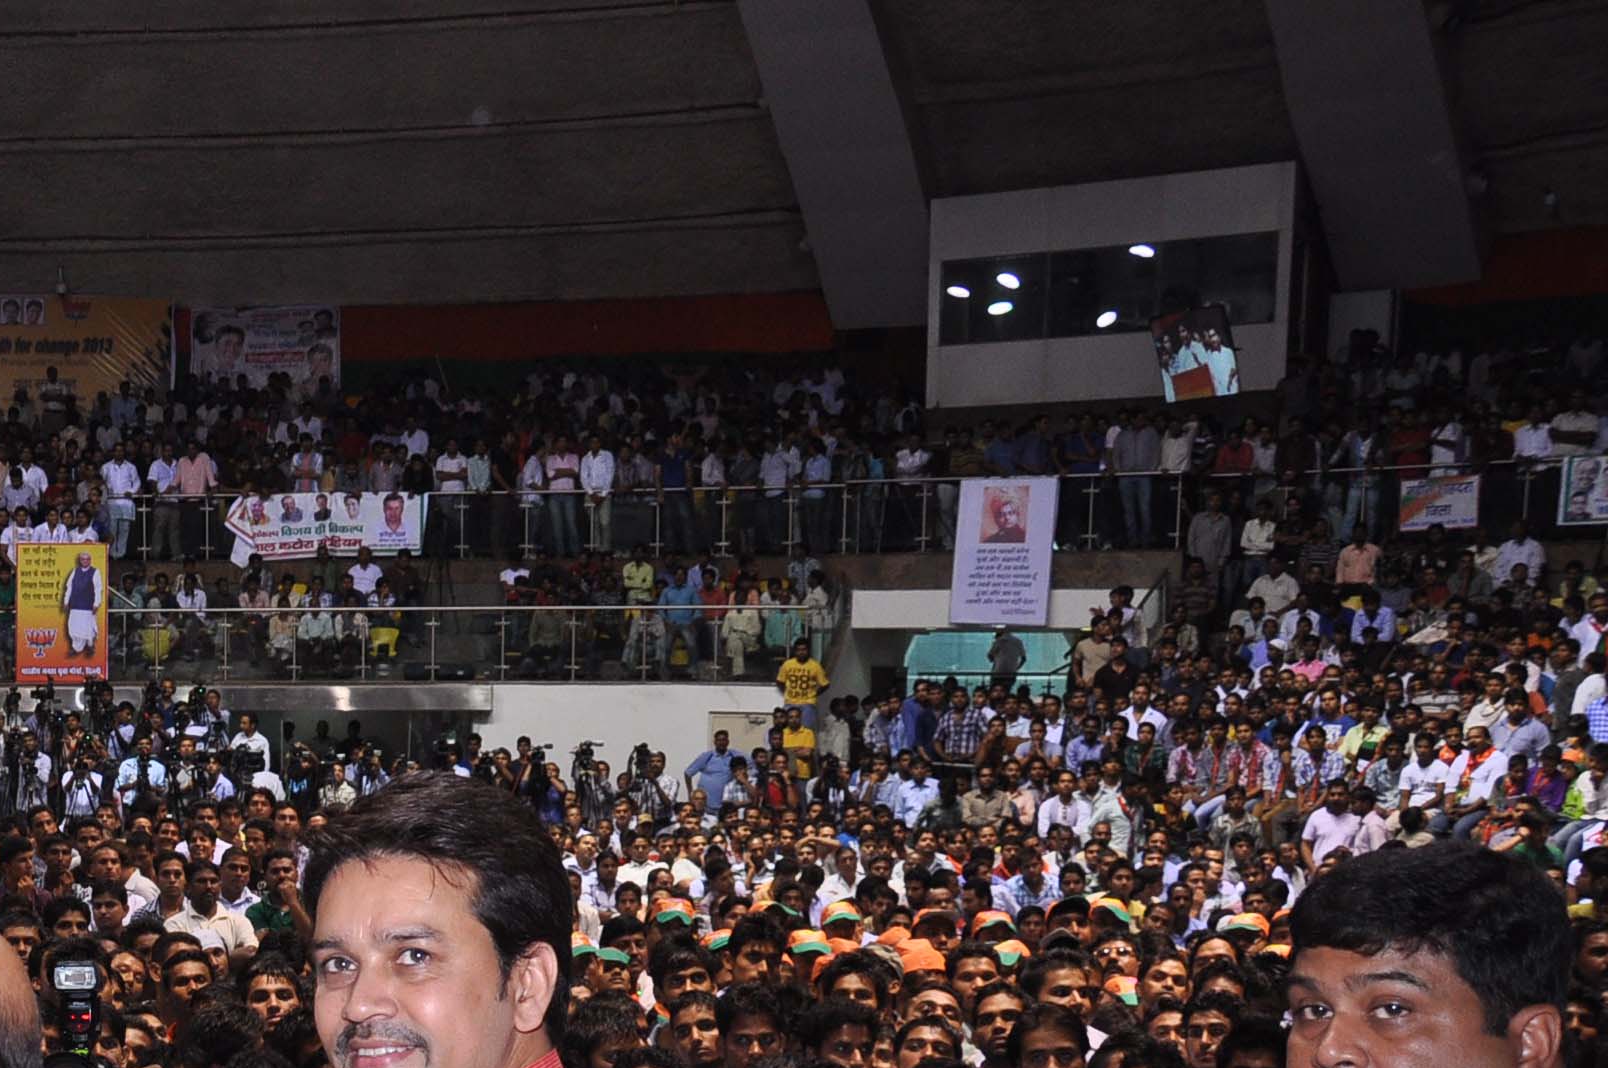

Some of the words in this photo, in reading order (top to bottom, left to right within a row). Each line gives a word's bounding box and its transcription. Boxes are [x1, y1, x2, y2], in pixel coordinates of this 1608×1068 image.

[15, 337, 33, 353] for
[281, 522, 313, 537] विजय
[314, 522, 327, 536] ही
[328, 521, 365, 534] विकल्प
[278, 537, 315, 551] कटोरा
